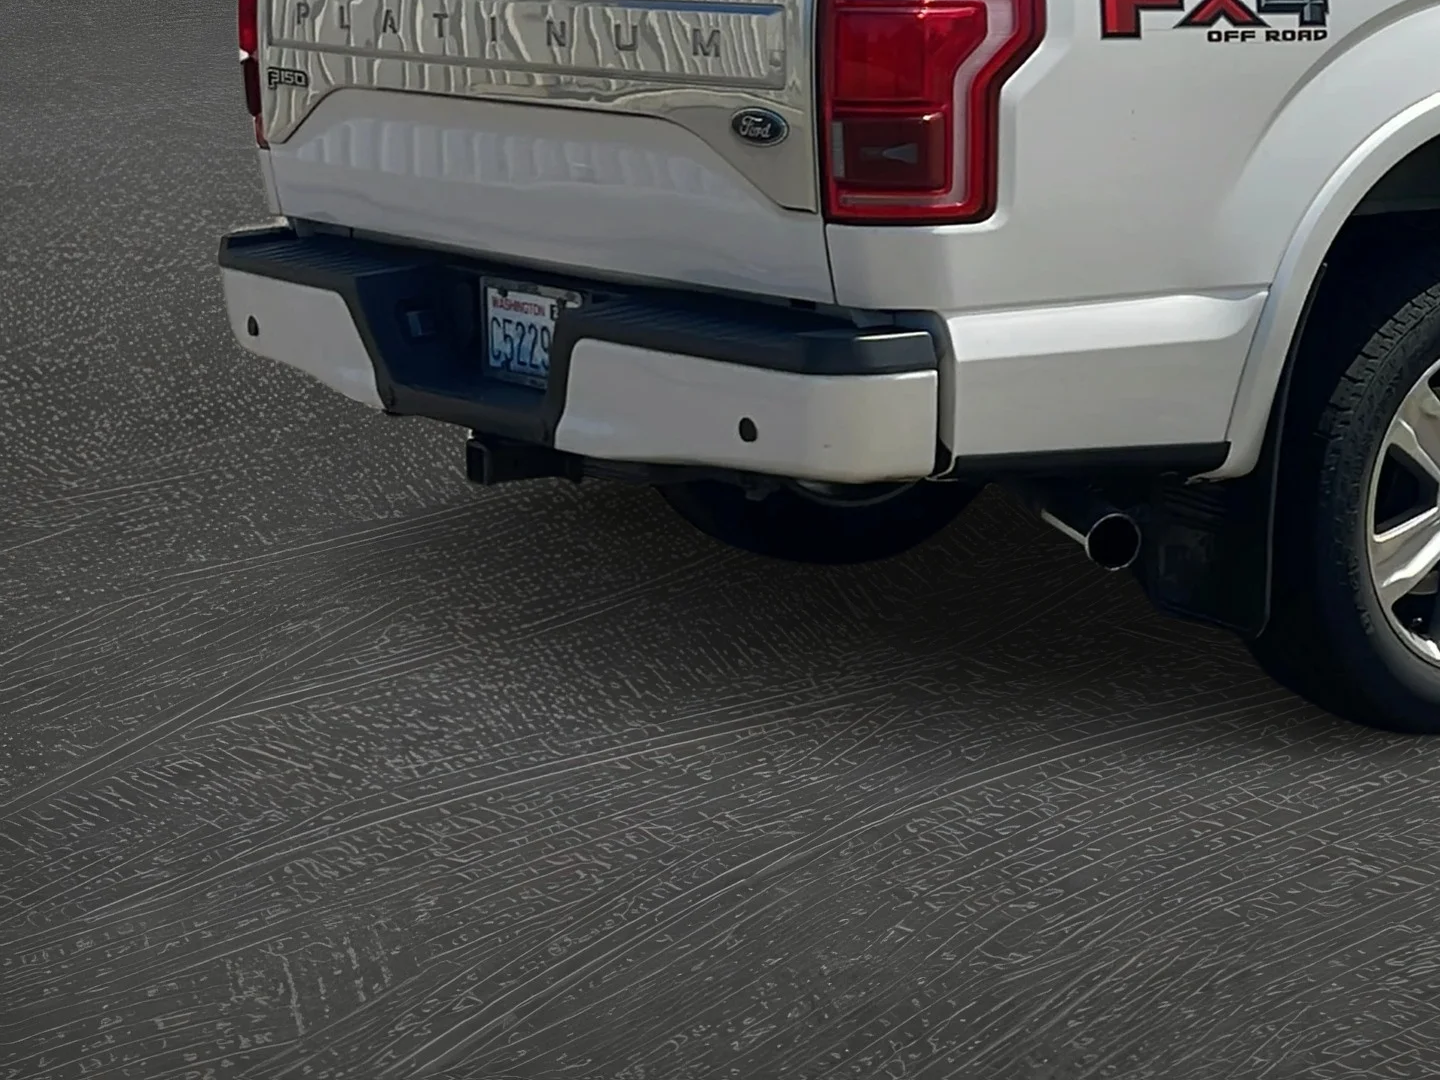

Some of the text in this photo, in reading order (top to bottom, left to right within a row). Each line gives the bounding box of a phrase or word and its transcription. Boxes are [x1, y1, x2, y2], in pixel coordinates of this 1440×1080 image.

[295, 0, 722, 59] PLATINUM
[1207, 29, 1327, 42] OFF ROAD
[740, 115, 772, 138] Ford
[491, 296, 546, 317] WASHINGTON
